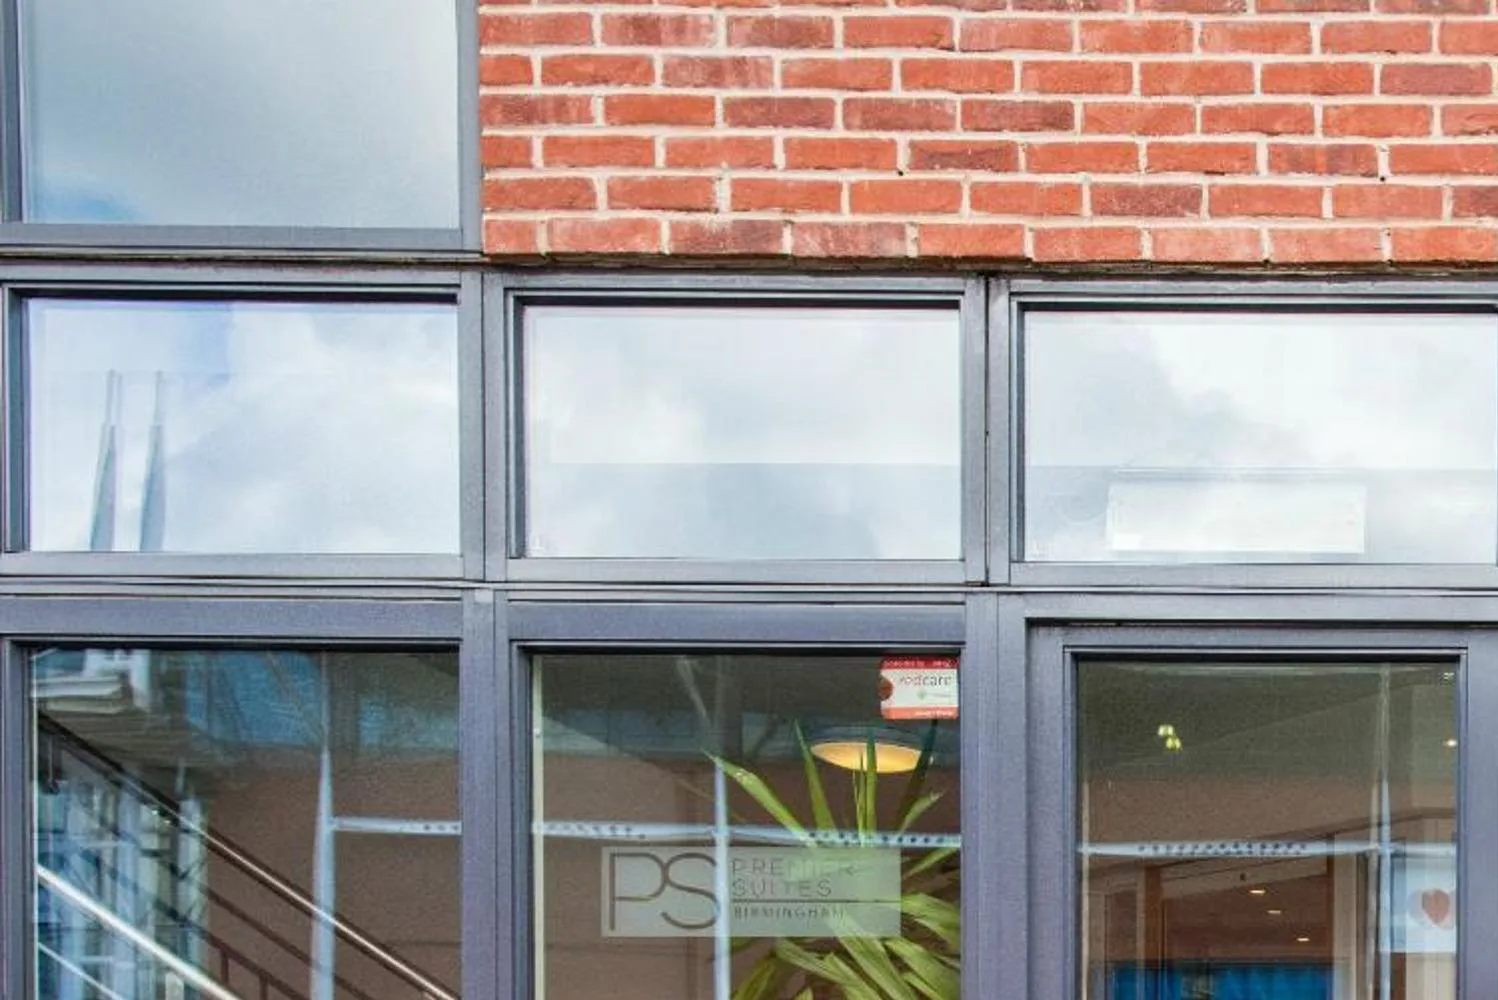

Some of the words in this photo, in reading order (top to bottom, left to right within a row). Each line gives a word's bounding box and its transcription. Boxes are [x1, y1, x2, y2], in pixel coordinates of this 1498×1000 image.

[608, 851, 721, 931] PS
[731, 879, 833, 898] SUITES
[733, 906, 845, 922] BIRMINGHAM
